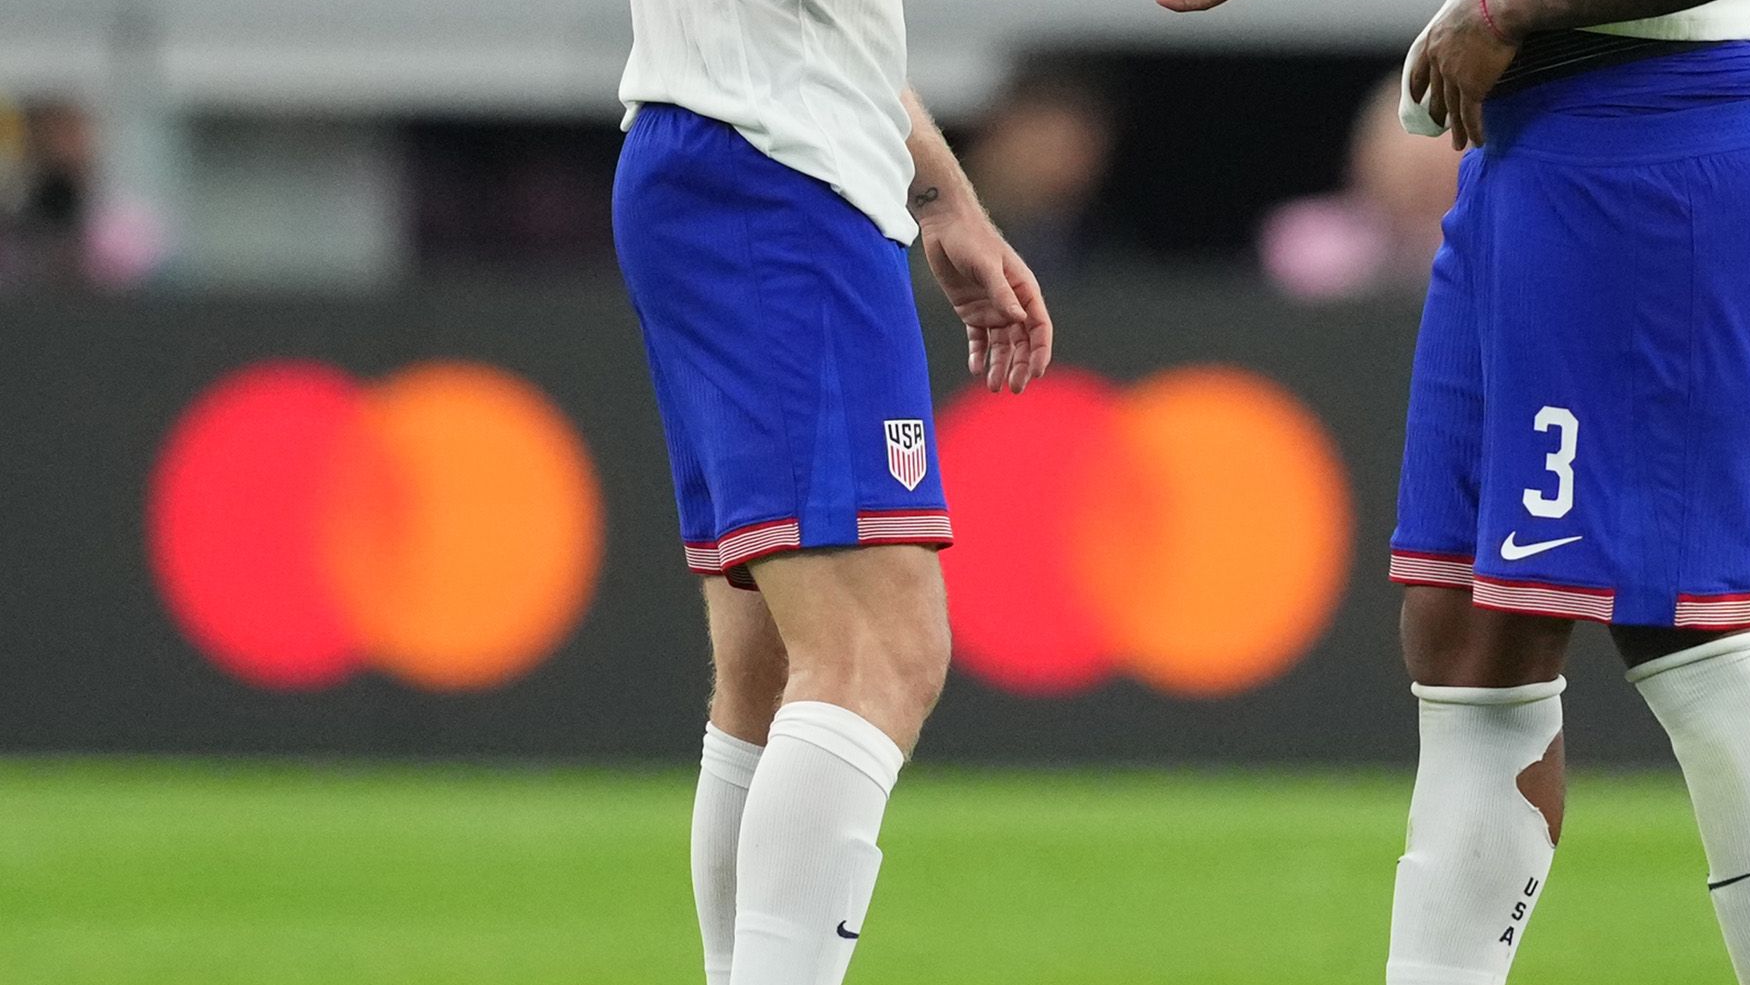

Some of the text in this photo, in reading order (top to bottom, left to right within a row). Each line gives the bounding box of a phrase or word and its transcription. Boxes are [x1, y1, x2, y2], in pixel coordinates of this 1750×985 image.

[888, 423, 922, 450] USA
[1522, 405, 1579, 519] 3
[1499, 877, 1539, 947] USA
